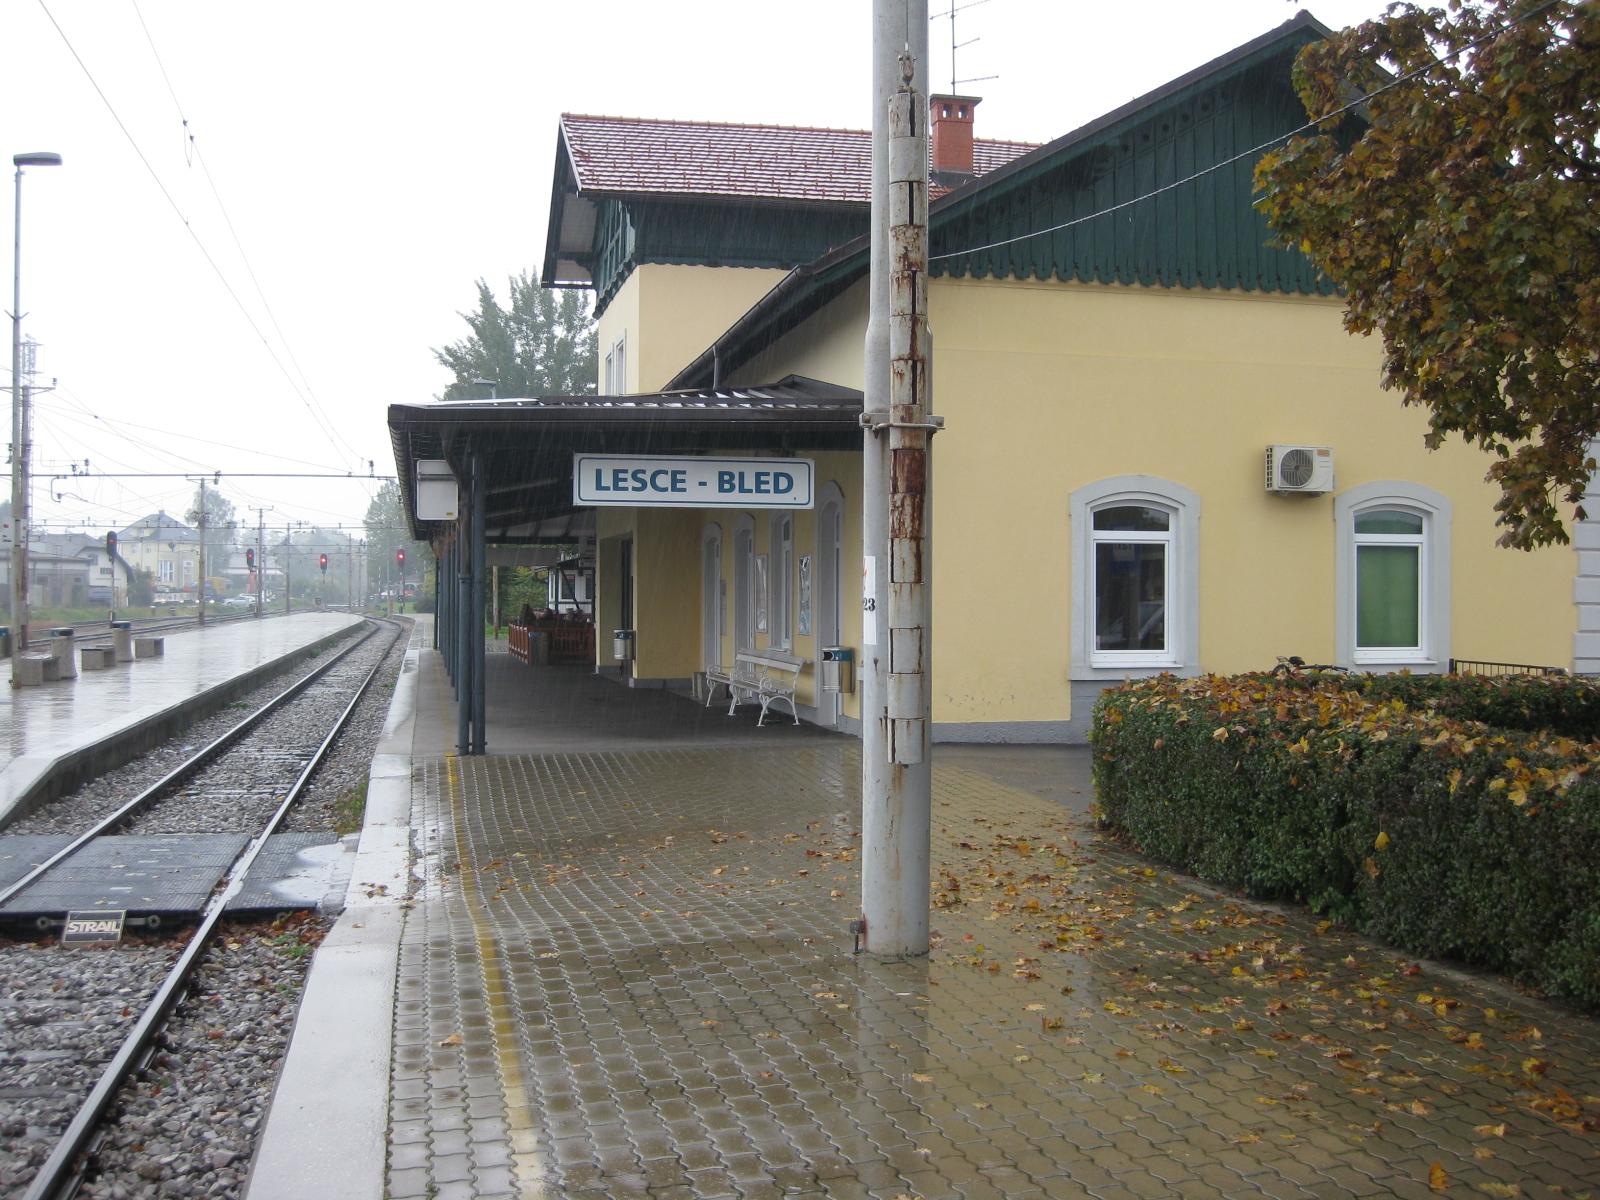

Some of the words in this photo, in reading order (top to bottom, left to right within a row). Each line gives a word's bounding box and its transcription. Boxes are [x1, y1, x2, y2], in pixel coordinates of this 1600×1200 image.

[595, 468, 687, 493] LESCE
[718, 470, 794, 495] BLED
[66, 921, 121, 933] STRAIL
